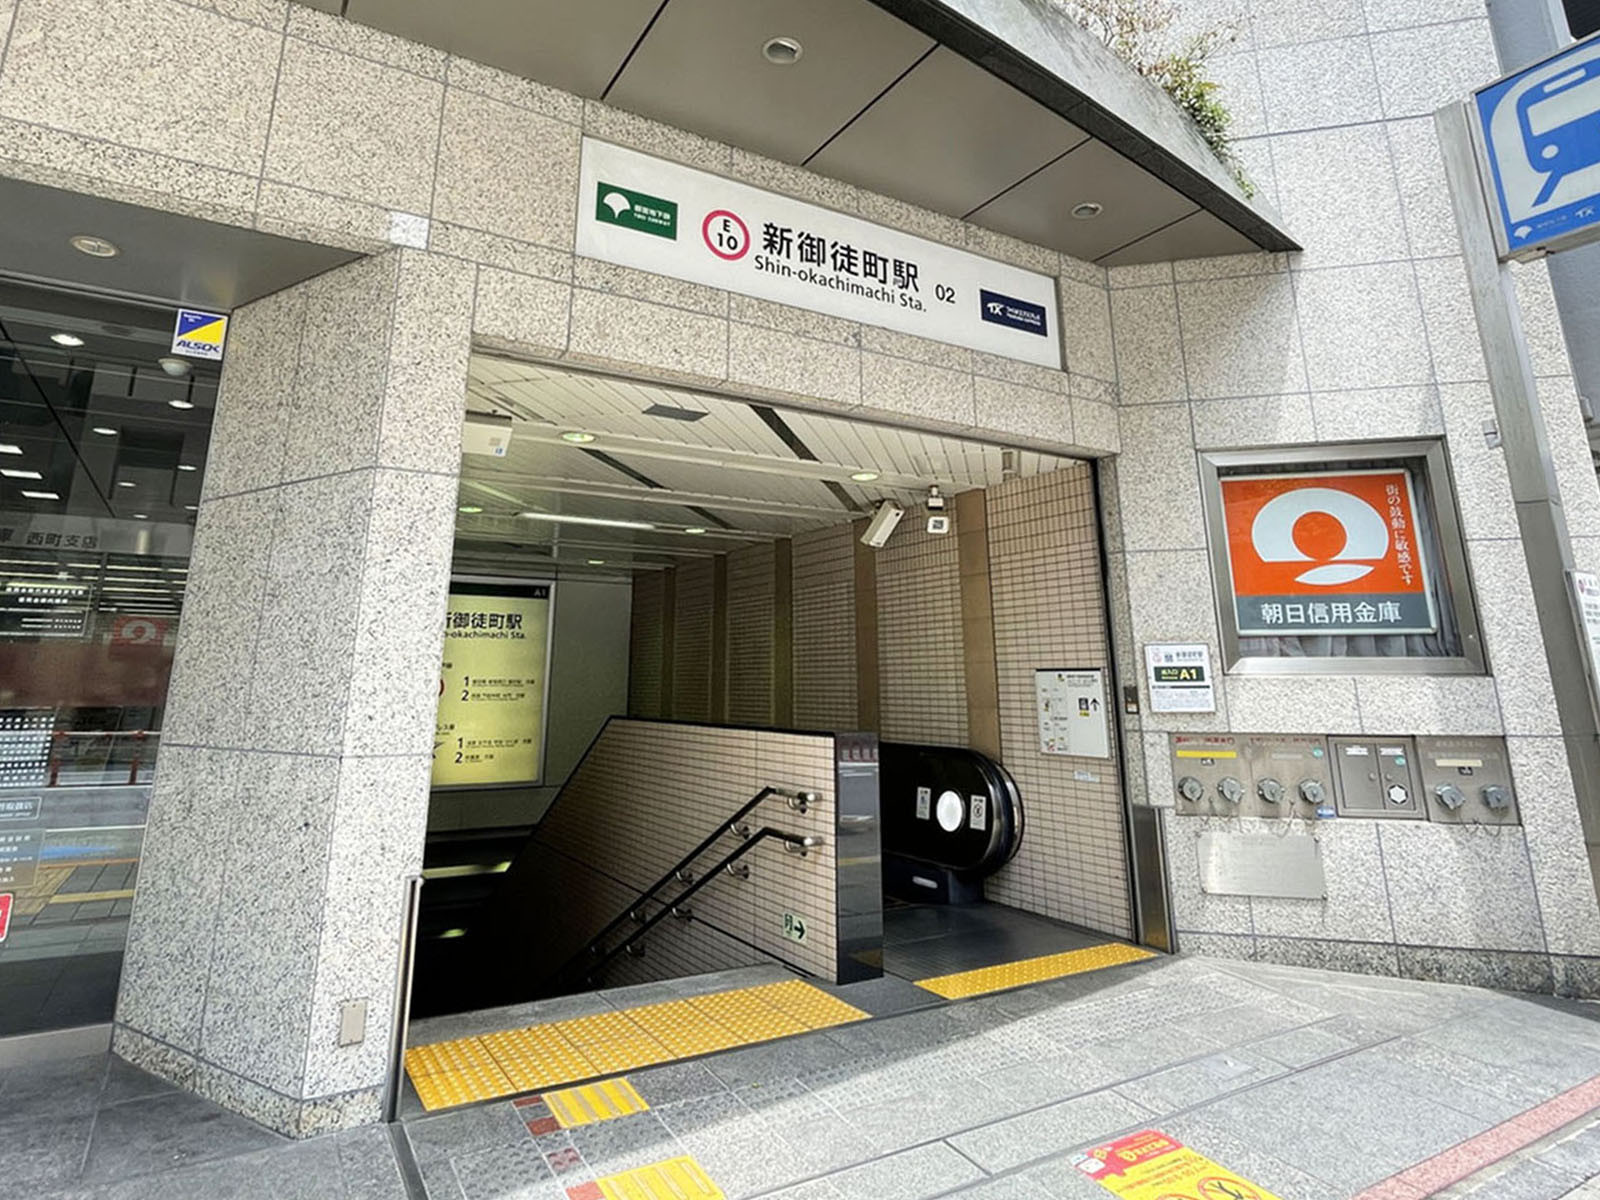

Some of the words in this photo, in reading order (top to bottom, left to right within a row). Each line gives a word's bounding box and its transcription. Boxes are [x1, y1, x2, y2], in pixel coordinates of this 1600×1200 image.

[723, 219, 731, 233] E
[717, 232, 738, 250] 10
[763, 222, 919, 292] 新御徒町駅
[754, 254, 895, 304] Shin-okachimachi
[899, 292, 927, 312] Sta.
[935, 283, 956, 304] 02
[987, 302, 1005, 316] TX
[176, 340, 220, 353] ALSOK
[1261, 601, 1402, 624] 朝日信用金庫
[464, 676, 469, 687] 1
[1180, 669, 1197, 680] A1
[461, 690, 469, 702] 2
[457, 737, 463, 749] 1
[455, 751, 463, 764] 2
